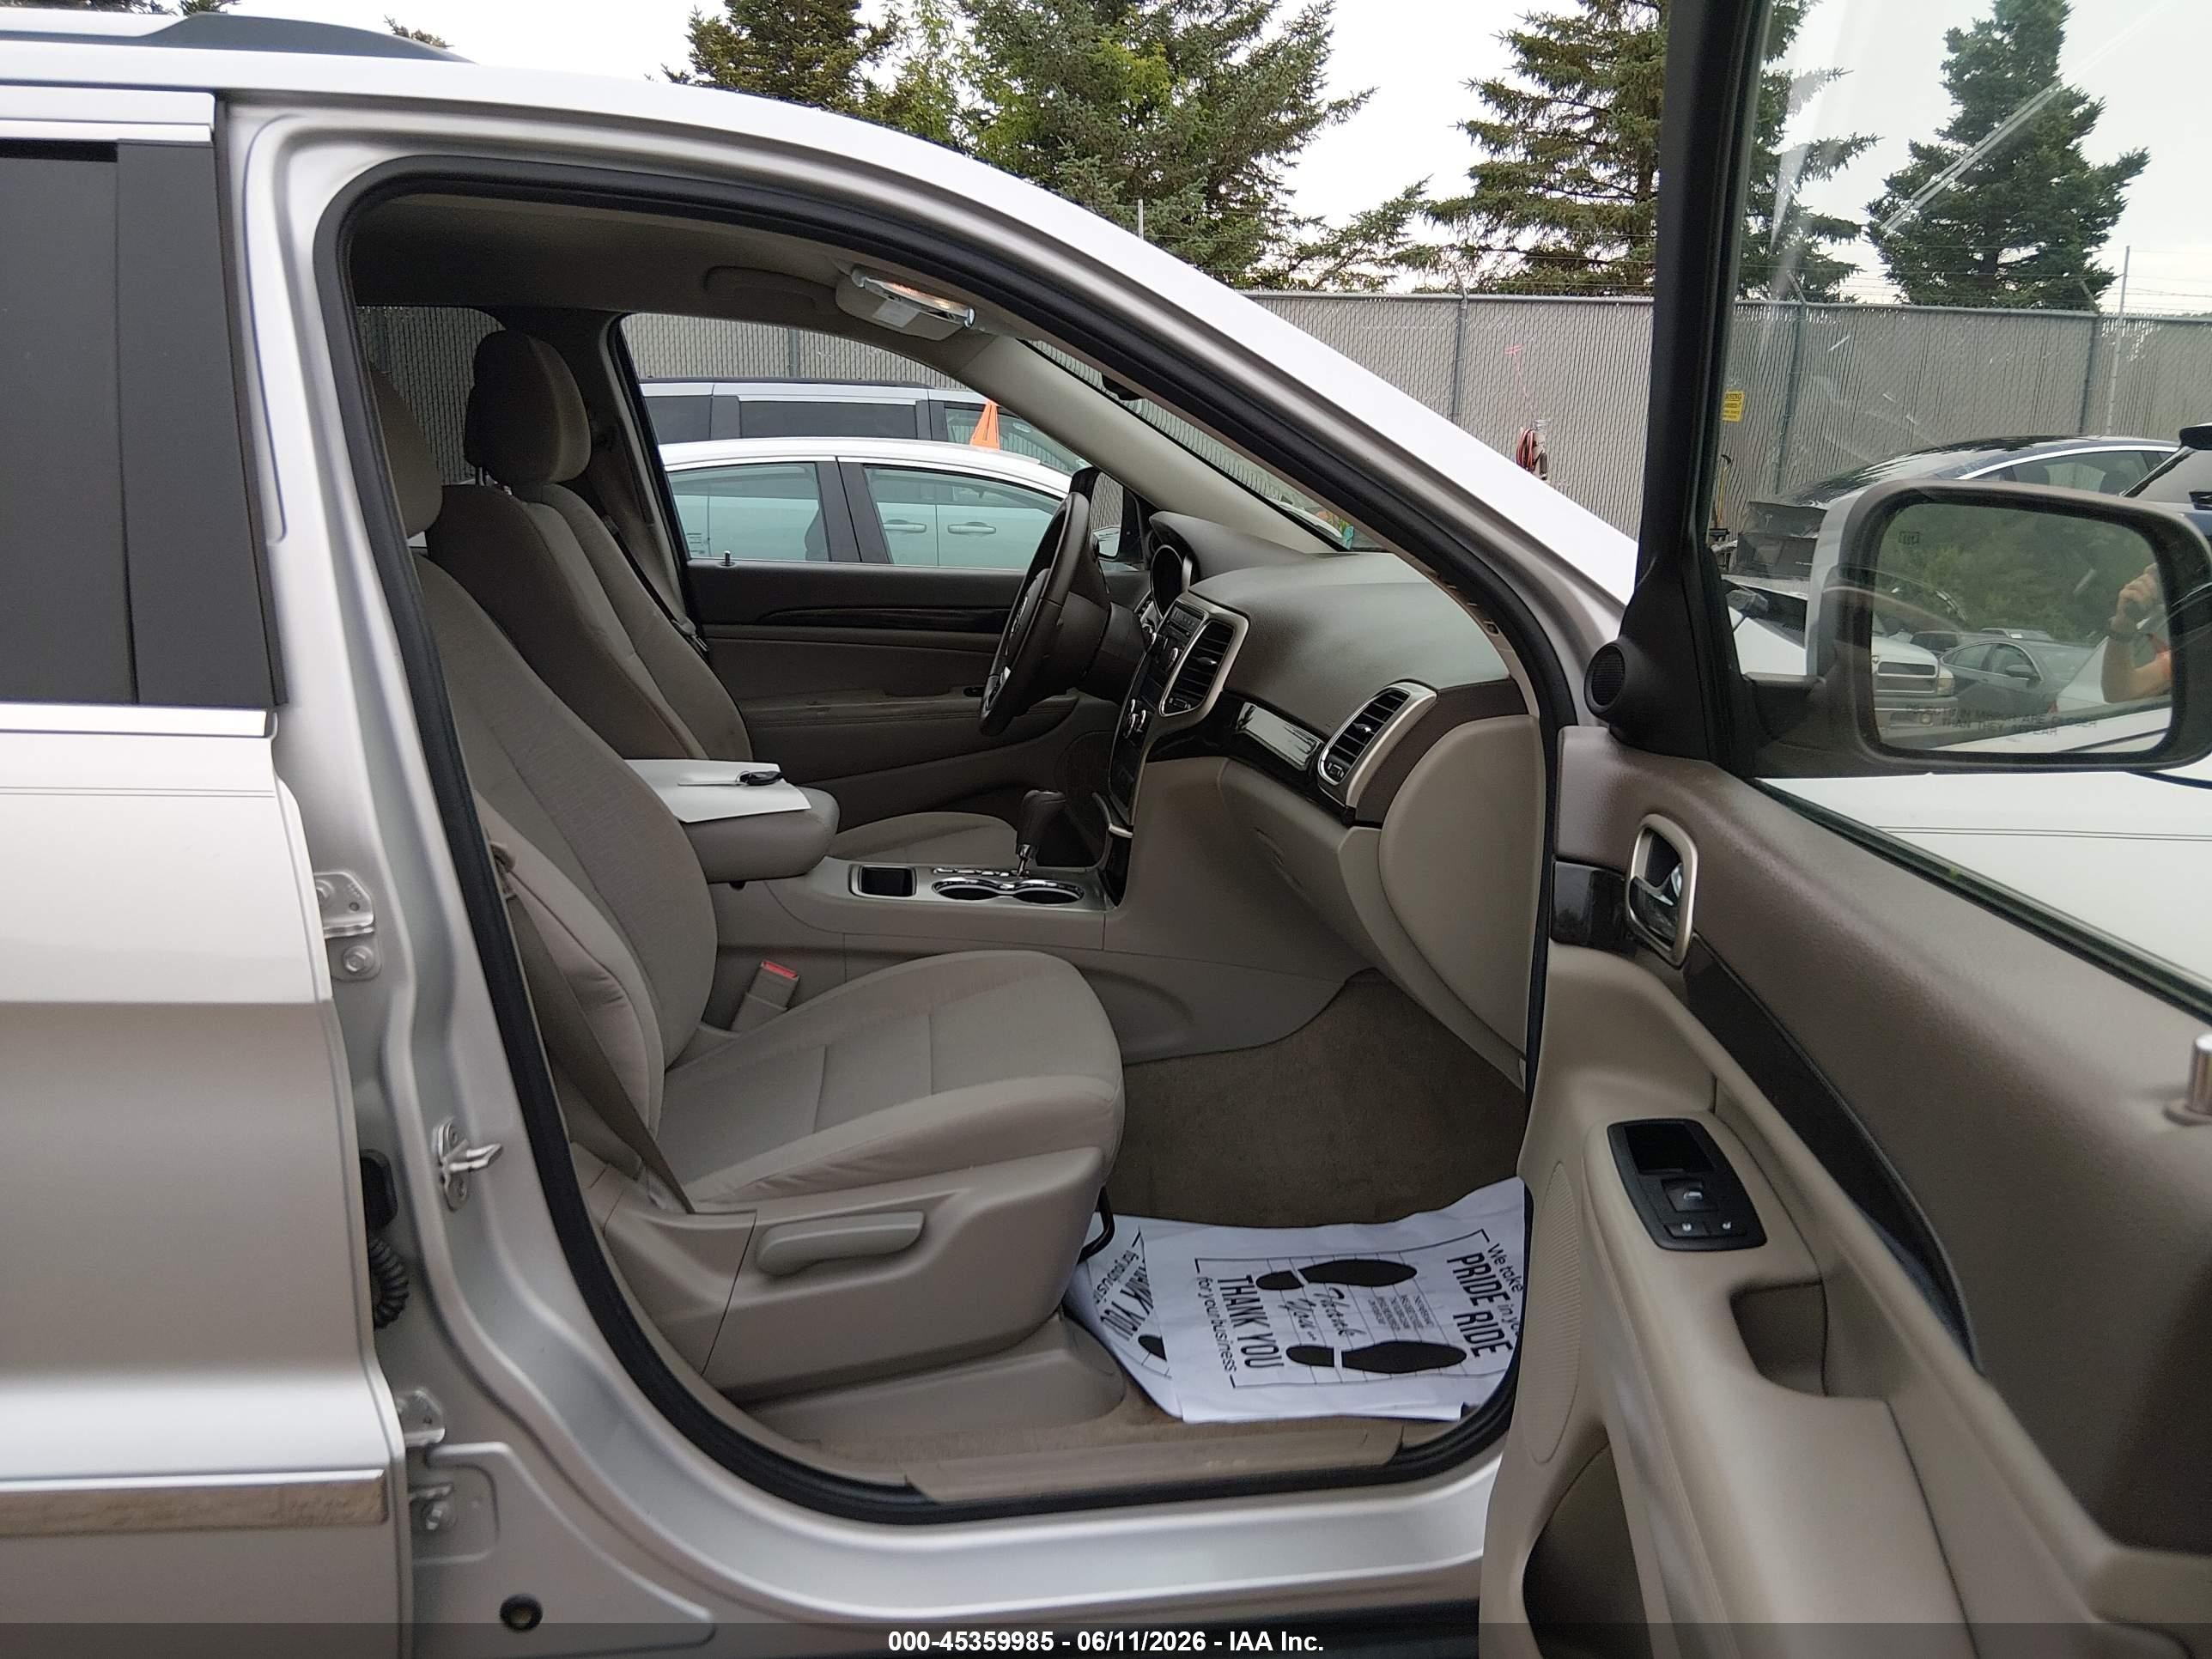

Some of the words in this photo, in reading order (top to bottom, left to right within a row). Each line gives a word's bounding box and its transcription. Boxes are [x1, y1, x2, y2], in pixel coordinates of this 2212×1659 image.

[1125, 1258, 1153, 1316] ANK
[1197, 1276, 1213, 1292] for
[1447, 1252, 1510, 1306] PRIDE
[1498, 1304, 1513, 1316] in
[1488, 1243, 1507, 1265] We
[1499, 1265, 1523, 1292] take
[1198, 1291, 1220, 1319] your
[1218, 1274, 1270, 1328] THANK
[1211, 1318, 1237, 1371] business
[1237, 1332, 1285, 1368] YOU
[1453, 1310, 1513, 1357] RIDE
